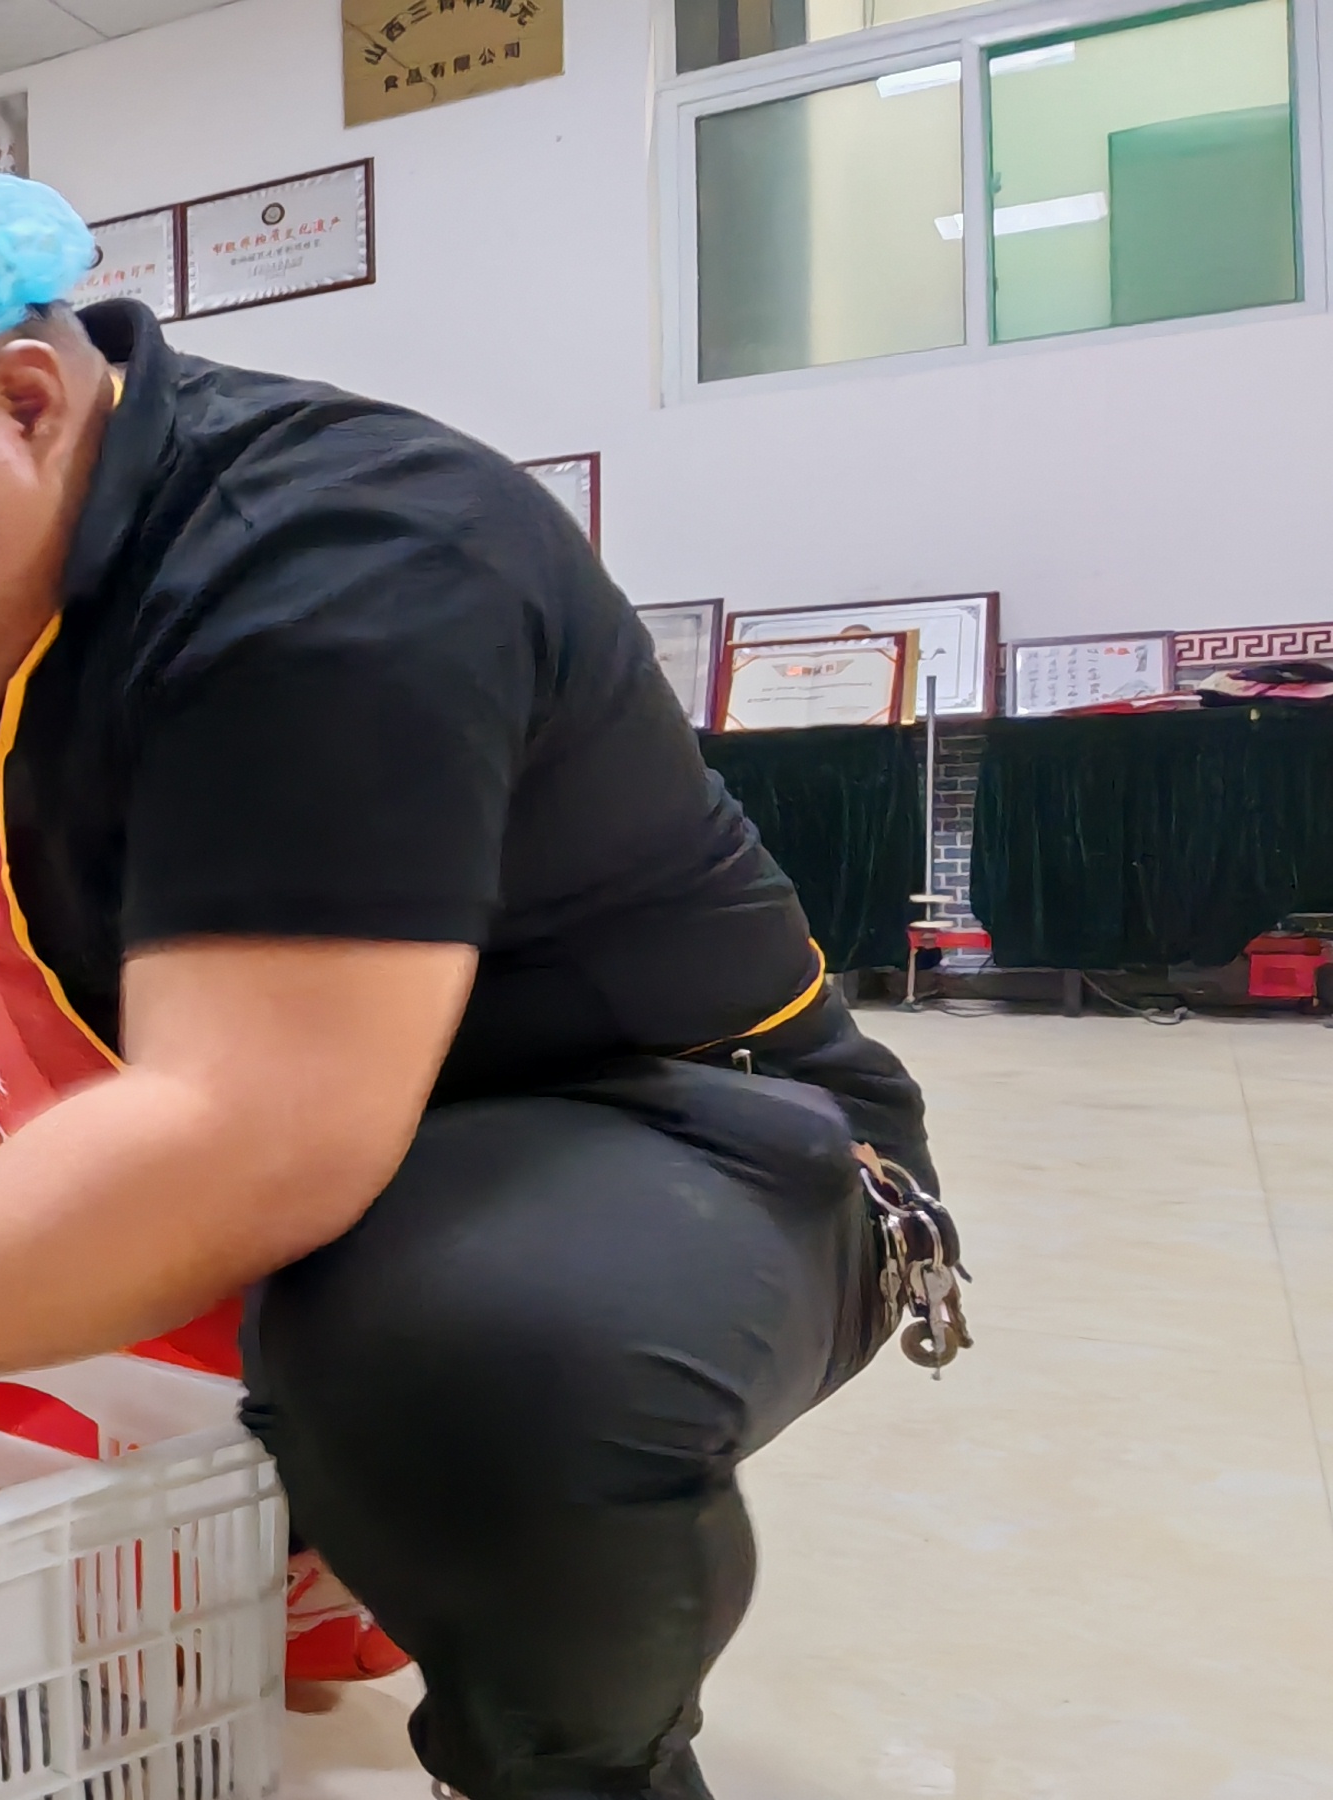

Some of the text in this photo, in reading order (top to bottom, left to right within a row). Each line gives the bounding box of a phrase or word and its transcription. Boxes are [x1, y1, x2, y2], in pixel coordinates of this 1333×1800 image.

[384, 41, 520, 92] 食品有限公司
